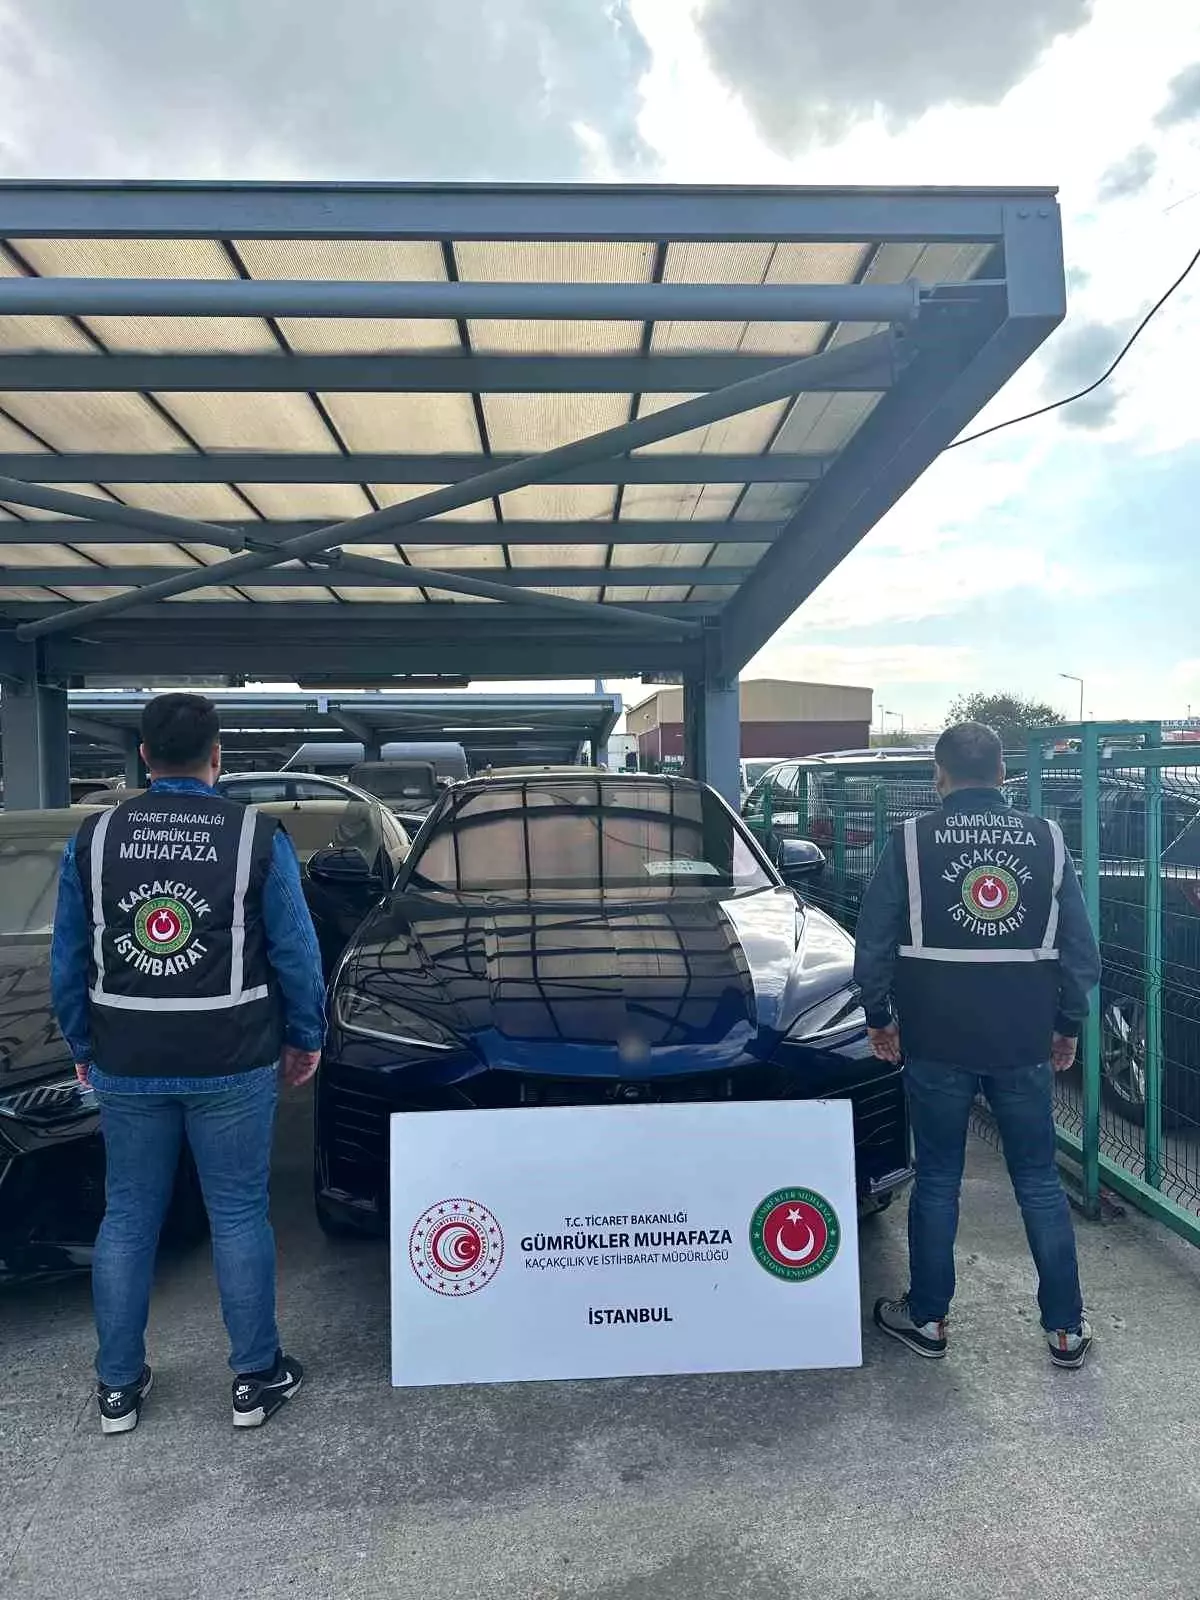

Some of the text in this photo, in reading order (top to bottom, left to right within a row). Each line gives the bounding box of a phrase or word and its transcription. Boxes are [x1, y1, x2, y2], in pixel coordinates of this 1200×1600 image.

[128, 810, 225, 826] TİCARET BAKANLIĞI
[946, 812, 1024, 829] GÜMRÜKLER
[133, 826, 210, 843] GÜMRÜKLER
[935, 830, 1037, 847] MUHAFAZA
[119, 842, 218, 862] MUHAFAZA
[941, 848, 1033, 886] KAÇAKÇILIK
[117, 879, 212, 918] KAÇAKÇILIK
[947, 901, 1028, 937] İSTİHBARAT
[113, 932, 208, 977] İSTİHBARAT
[564, 1211, 688, 1227] T.C. TİCARET BAKANLIĞI
[520, 1229, 733, 1251] GÜMRÜKLER MUHAFAZA
[525, 1256, 585, 1270] KAÇAKÇILIK
[586, 1255, 600, 1266] VE
[662, 1249, 729, 1263] MÜDÜRLÜĞÜ
[588, 1307, 673, 1324] İSTANBUL
